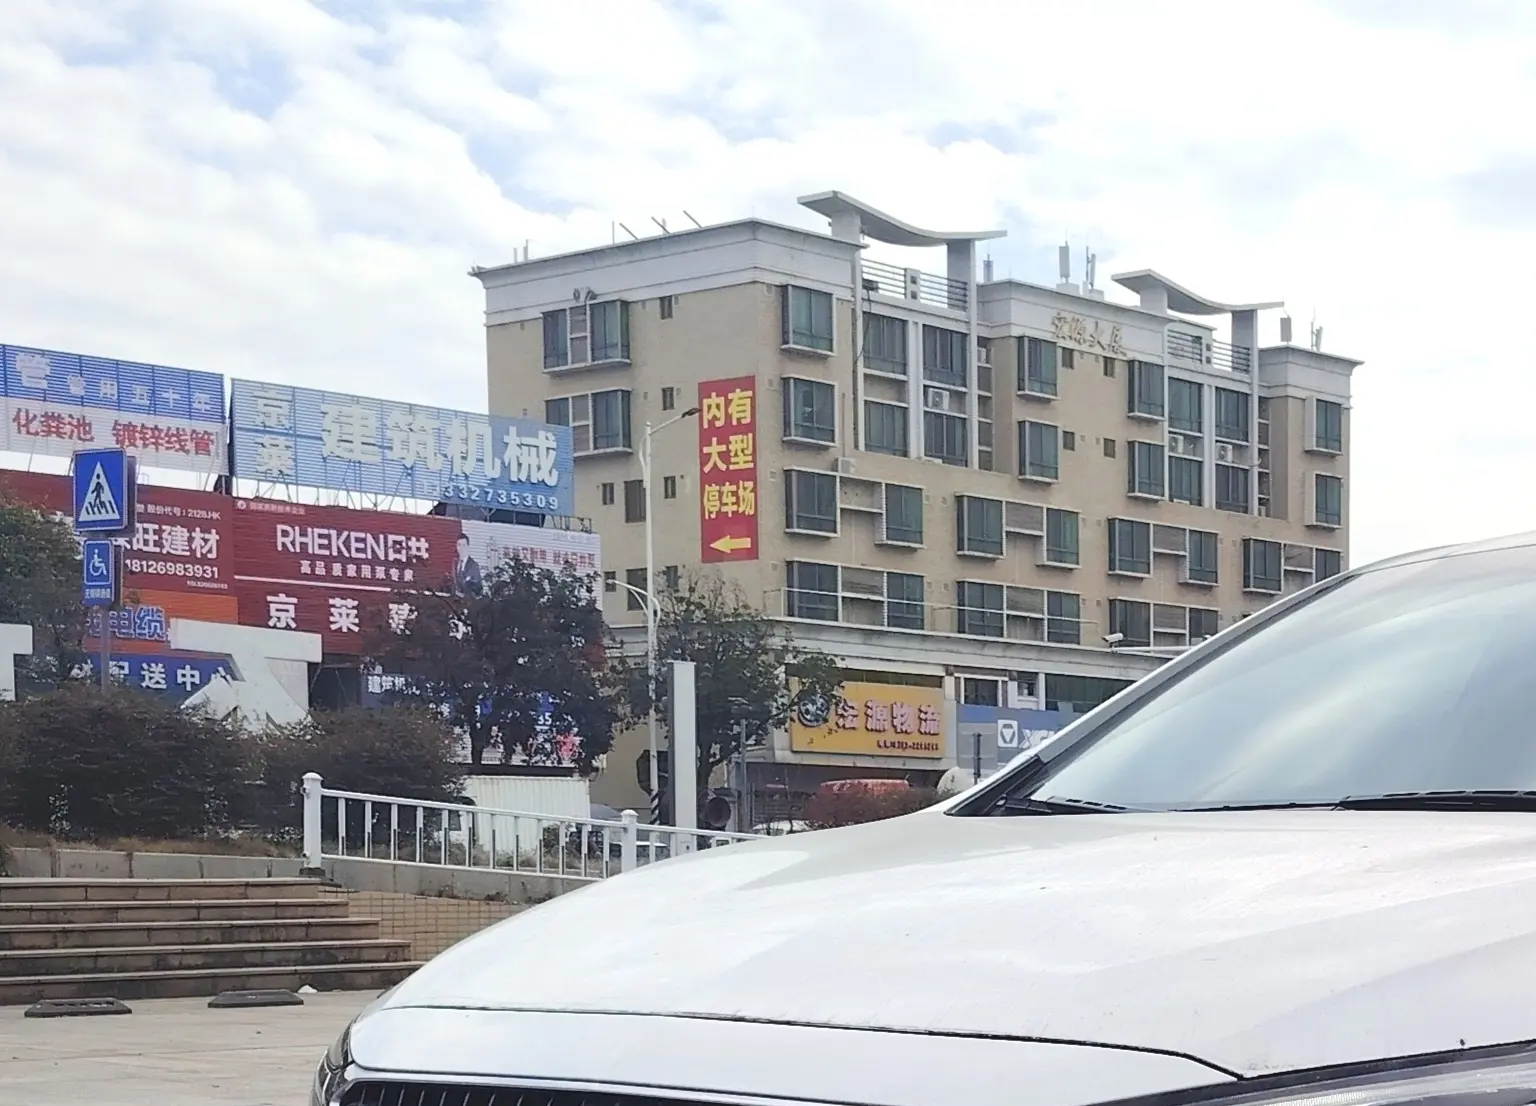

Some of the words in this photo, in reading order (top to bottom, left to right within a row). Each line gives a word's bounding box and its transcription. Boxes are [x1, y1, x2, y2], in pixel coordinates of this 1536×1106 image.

[702, 388, 753, 429] 内有
[12, 407, 94, 442] 化粪池
[112, 419, 214, 456] 镀锌线管
[321, 402, 559, 487] 建筑机械
[703, 433, 754, 473] 大型
[703, 480, 755, 520] 停车场
[110, 523, 220, 559] 旺建材
[125, 559, 218, 579] 18126983931
[300, 560, 414, 583] 高品质家用泵专家
